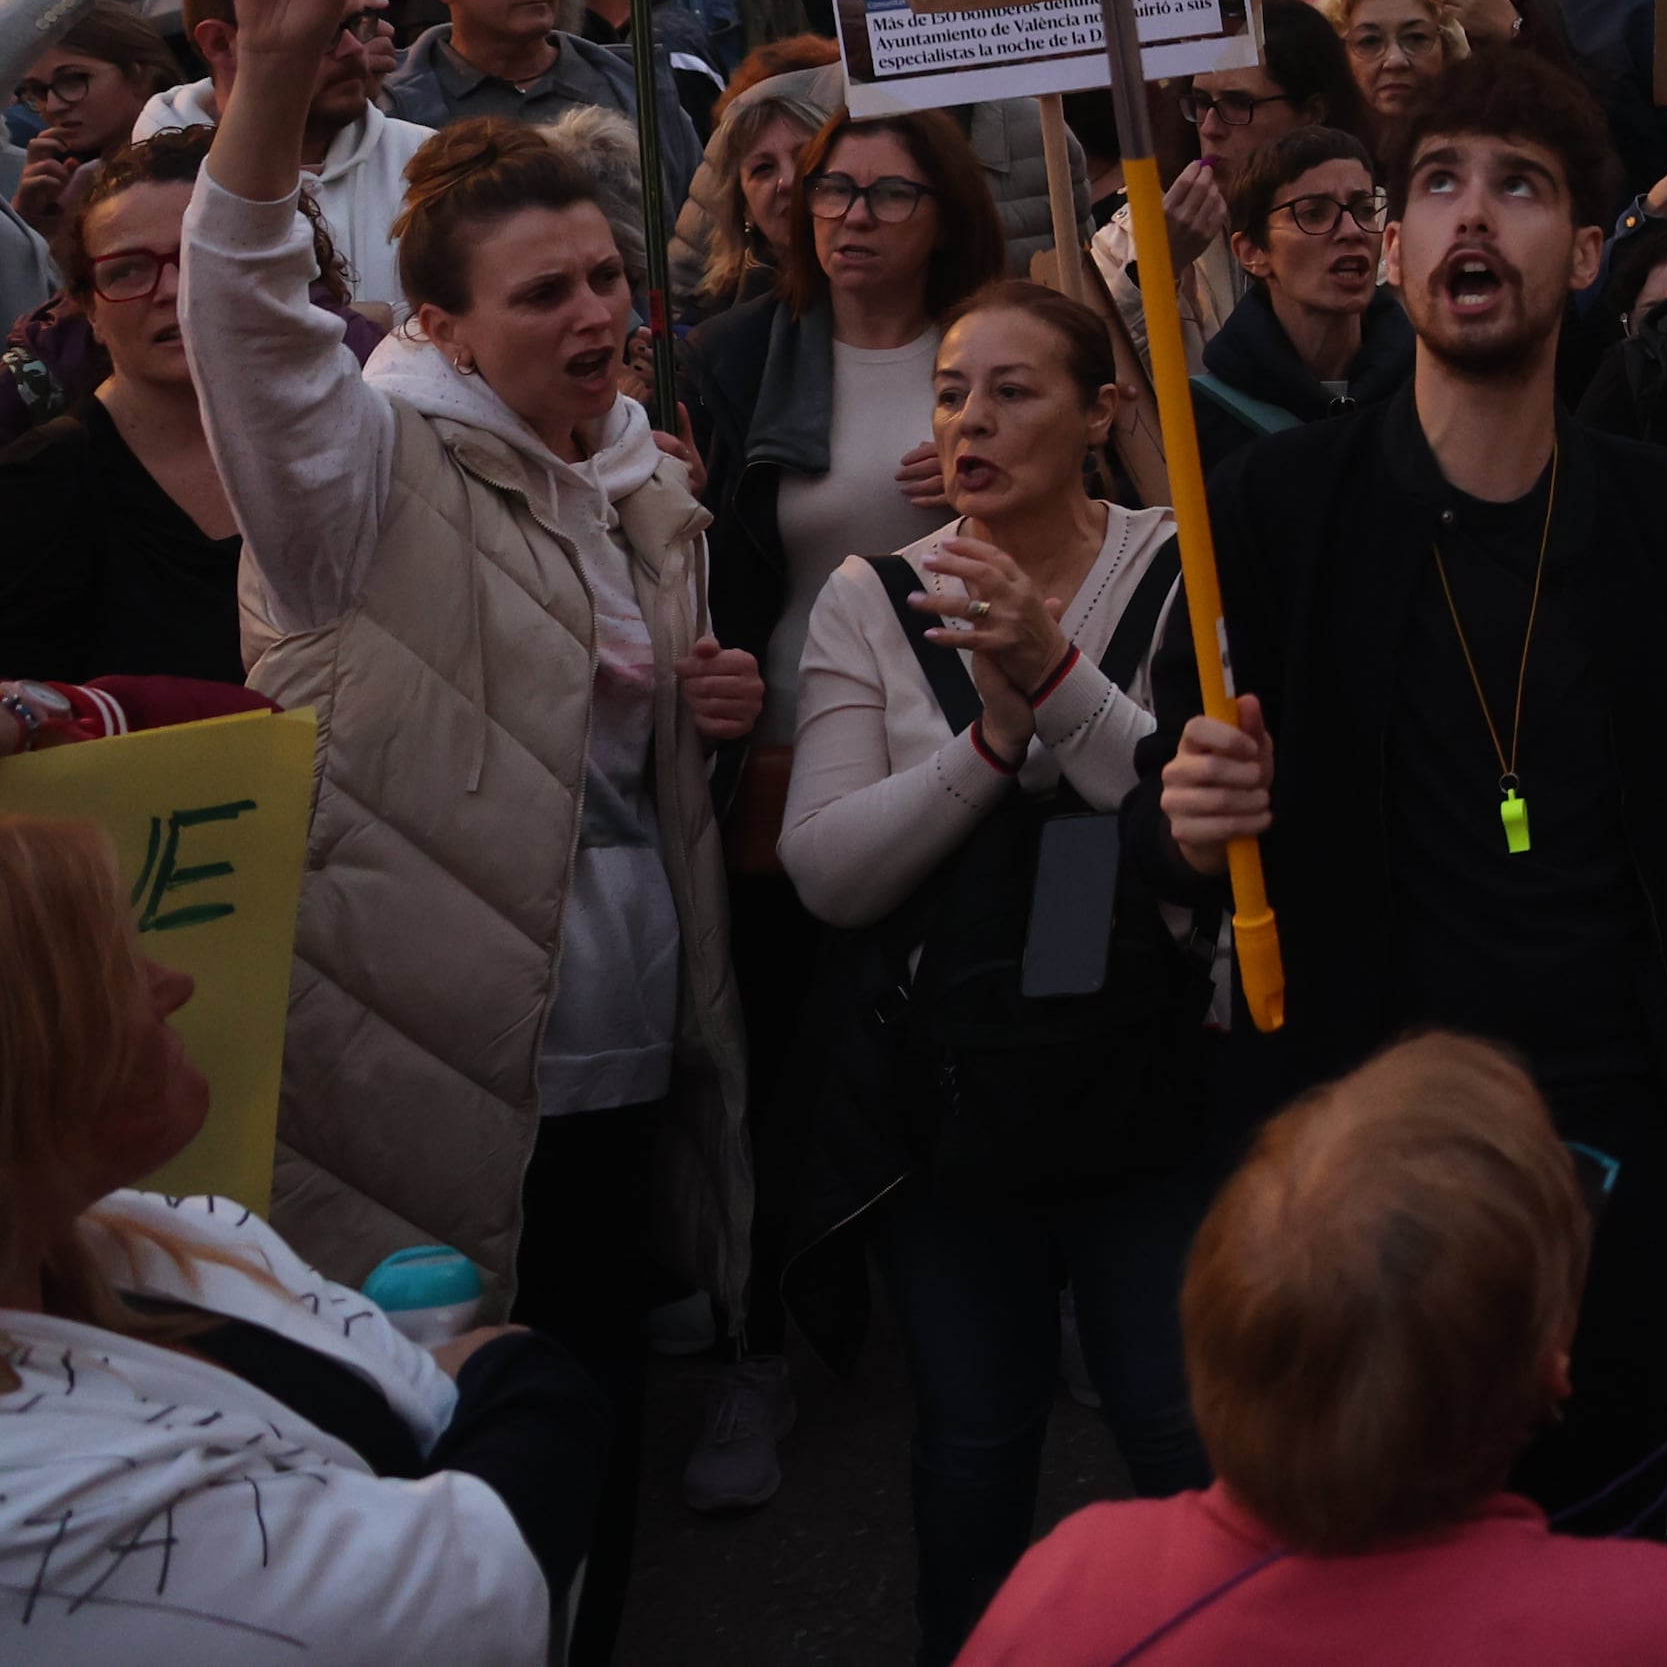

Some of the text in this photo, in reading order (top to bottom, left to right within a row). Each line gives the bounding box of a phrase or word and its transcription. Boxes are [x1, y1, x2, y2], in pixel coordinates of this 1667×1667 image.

[873, 17, 904, 32] Más
[908, 14, 927, 28] de
[877, 26, 988, 52] Ayuntamiento
[991, 22, 1010, 36] de
[1175, 2, 1184, 13] a
[879, 46, 976, 72] especialistas
[979, 41, 993, 56] la
[997, 34, 1045, 54] noche
[1049, 33, 1068, 47] de
[1072, 29, 1086, 45] la
